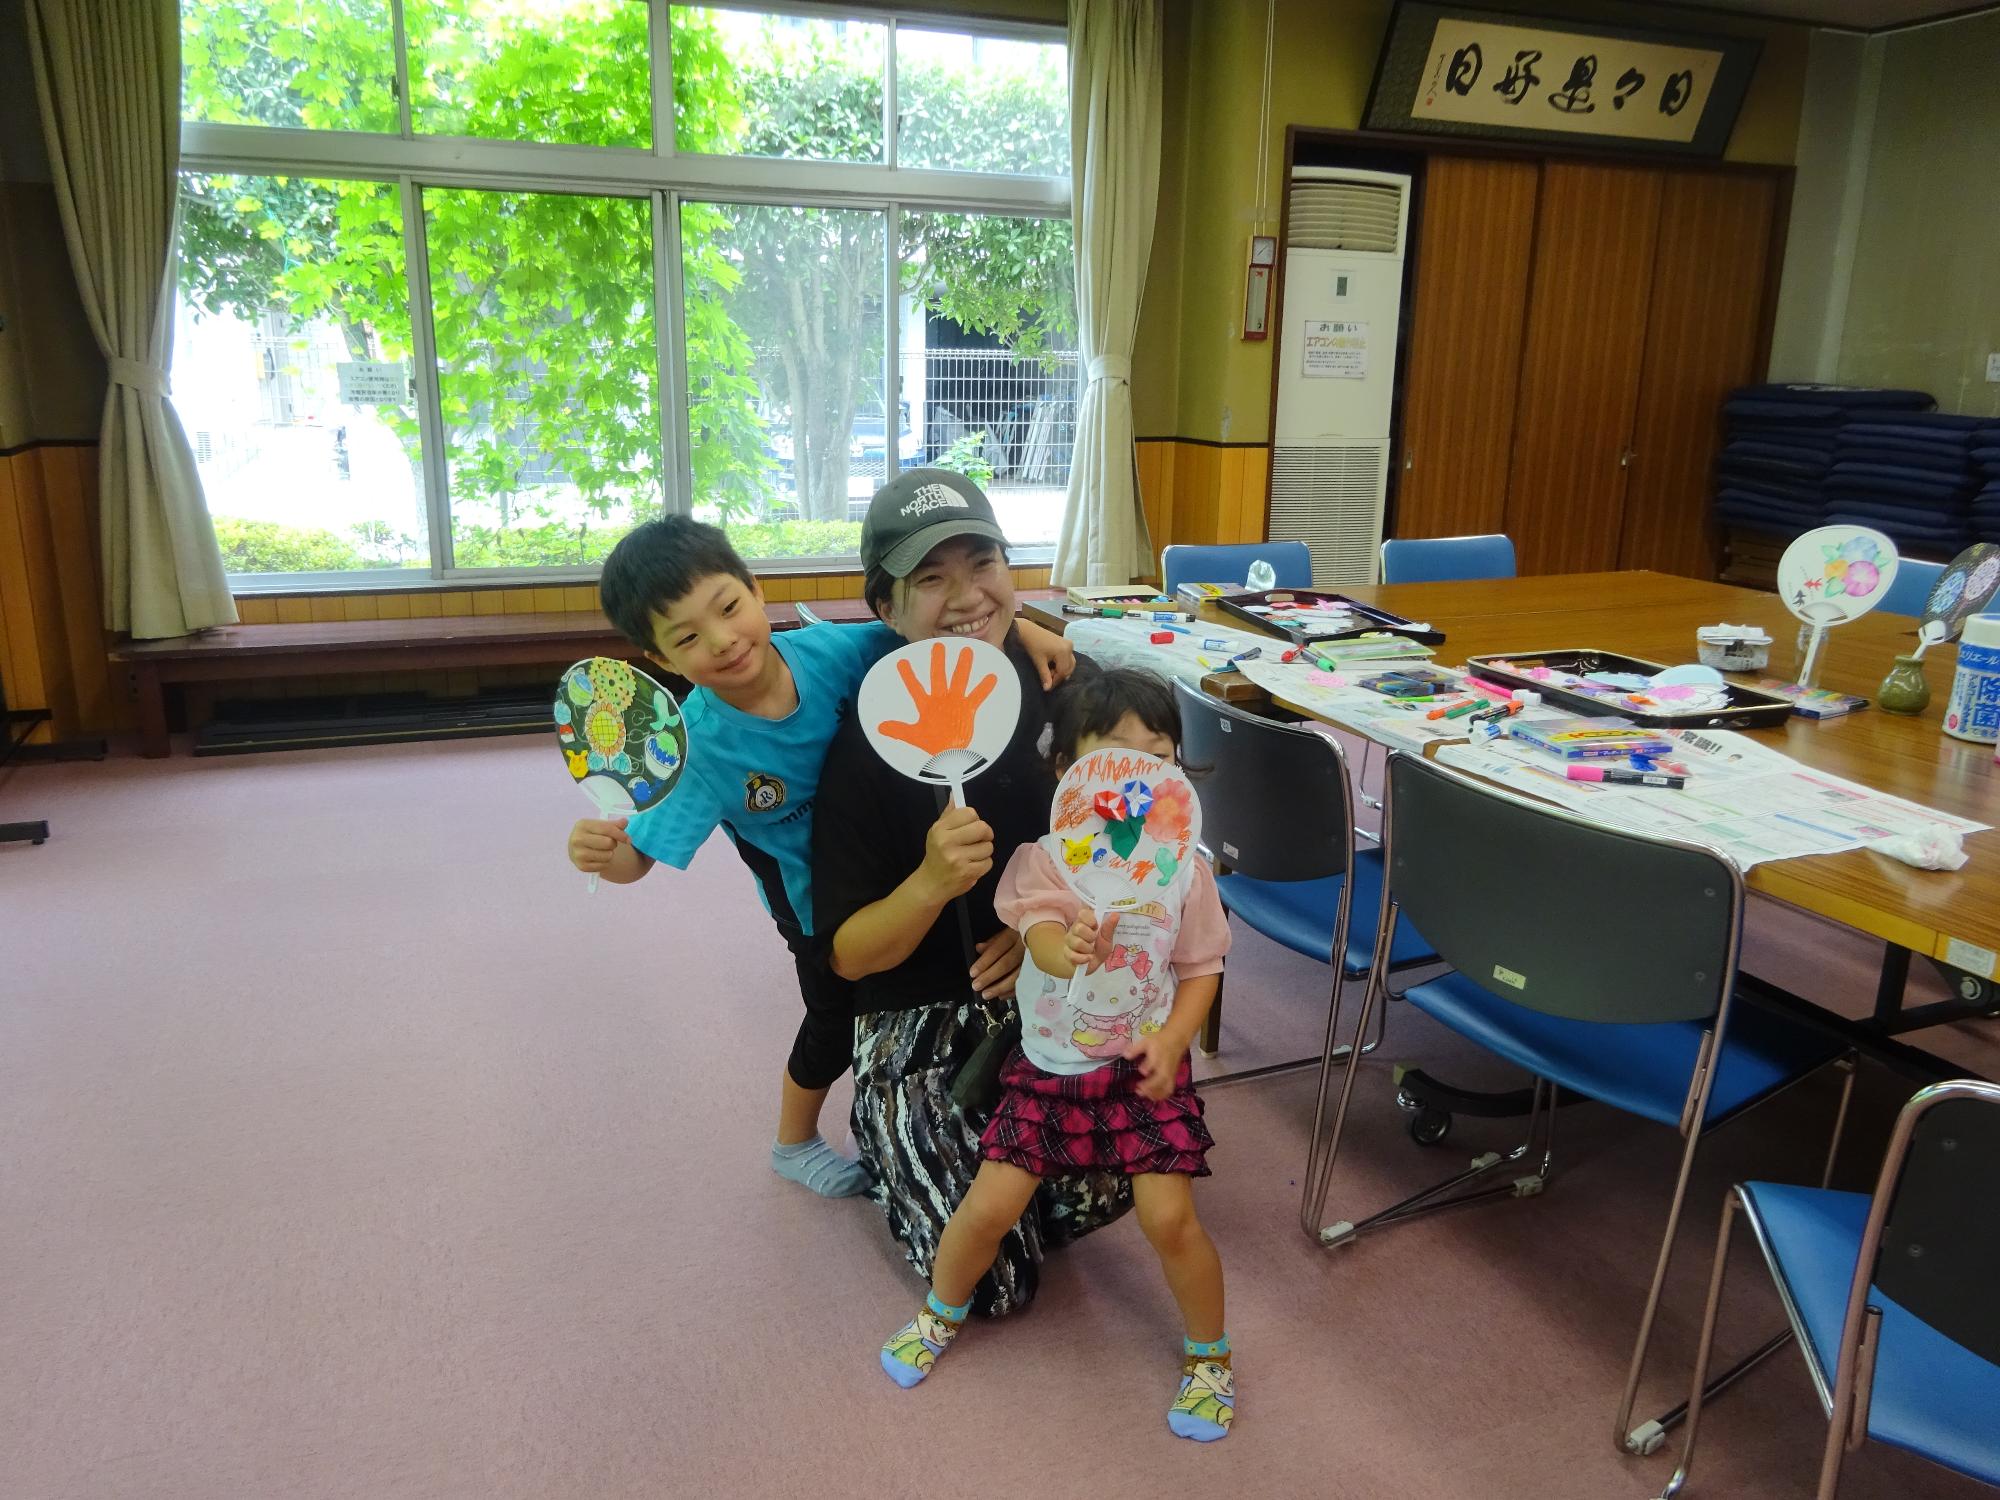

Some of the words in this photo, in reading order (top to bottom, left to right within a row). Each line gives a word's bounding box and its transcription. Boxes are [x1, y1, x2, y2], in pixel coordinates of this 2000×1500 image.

[913, 484, 940, 496] THE
[900, 491, 945, 516] NORTH
[915, 498, 949, 517] FACE
